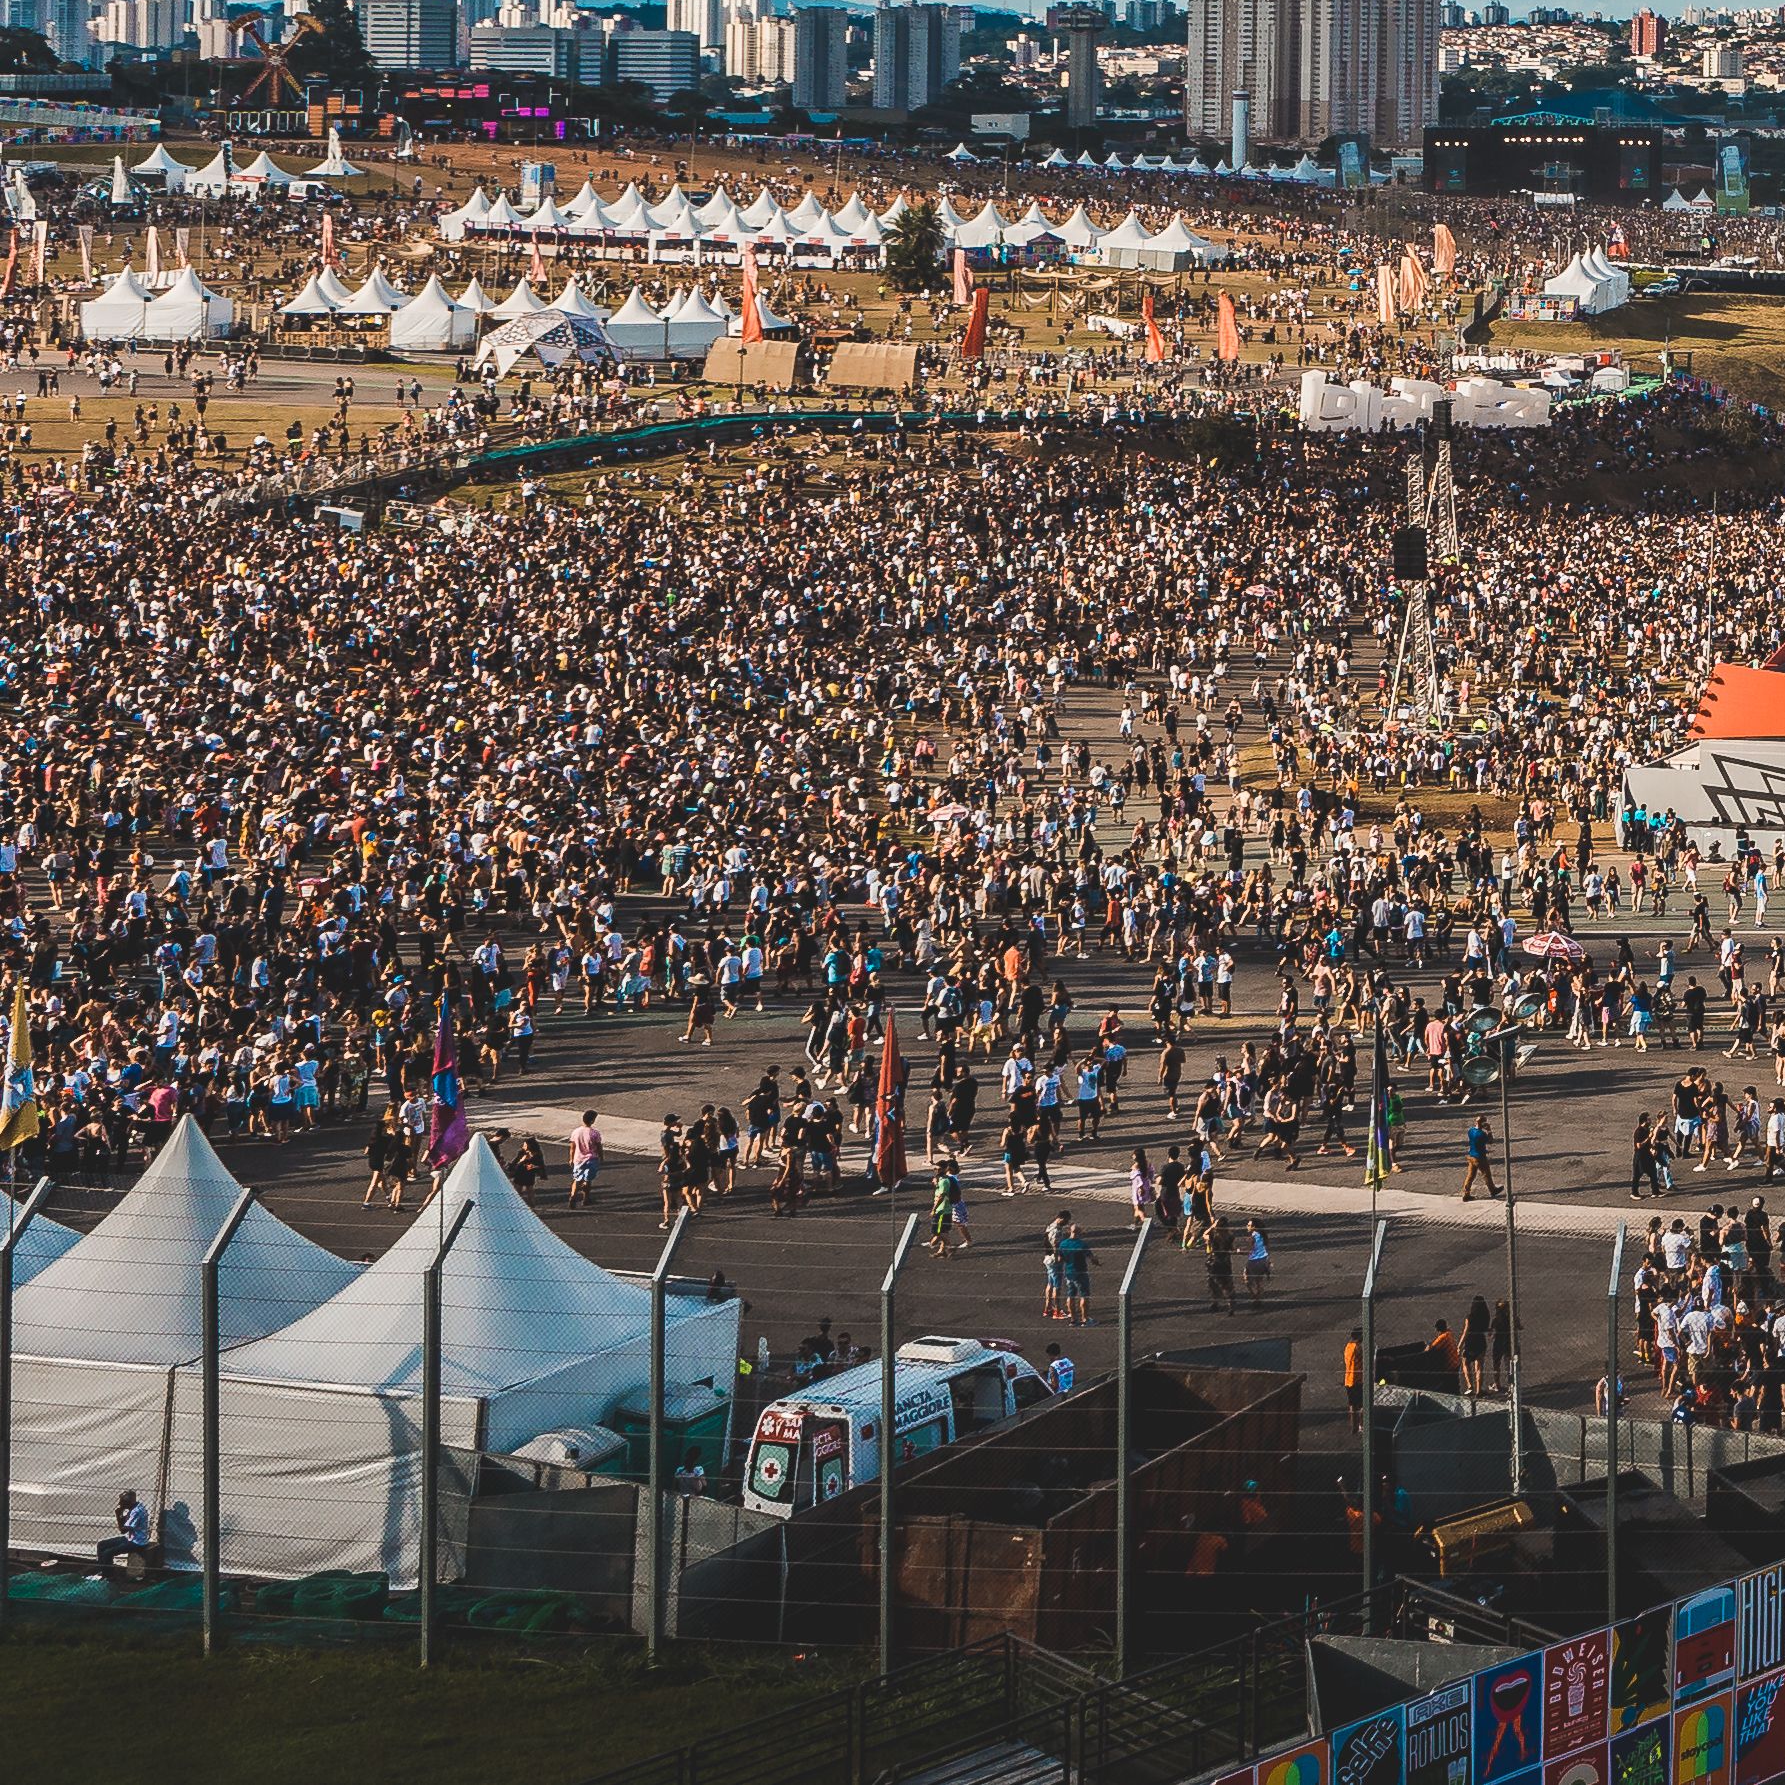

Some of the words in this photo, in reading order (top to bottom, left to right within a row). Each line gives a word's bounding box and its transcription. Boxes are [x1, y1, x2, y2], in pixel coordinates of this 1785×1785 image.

[894, 1390, 933, 1413] ANCTA
[1550, 1642, 1604, 1704] BUDWEISER
[1412, 1688, 1464, 1723] AXE
[1747, 1691, 1778, 1713] YOU
[1740, 1716, 1774, 1746] THAT
[1741, 1706, 1772, 1732] LIKE
[1409, 1712, 1469, 1773] RÓTULOS
